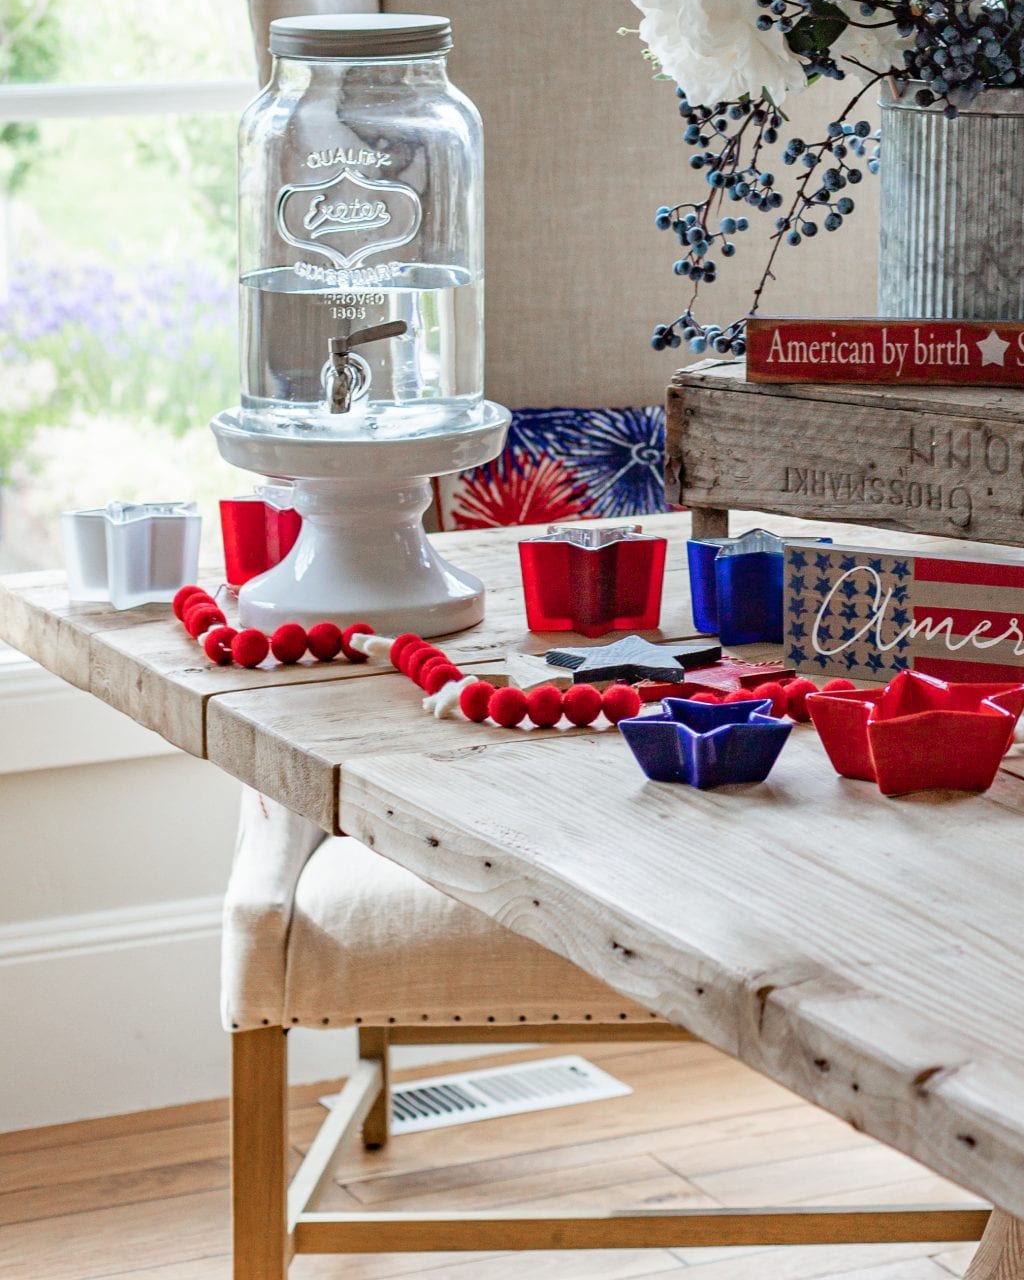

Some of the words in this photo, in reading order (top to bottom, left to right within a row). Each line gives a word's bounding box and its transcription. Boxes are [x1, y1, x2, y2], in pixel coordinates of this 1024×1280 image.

[306, 147, 393, 168] QUALITY
[304, 195, 391, 239] Exeter
[766, 328, 876, 364] American
[882, 328, 909, 377] by
[914, 328, 970, 366] birth
